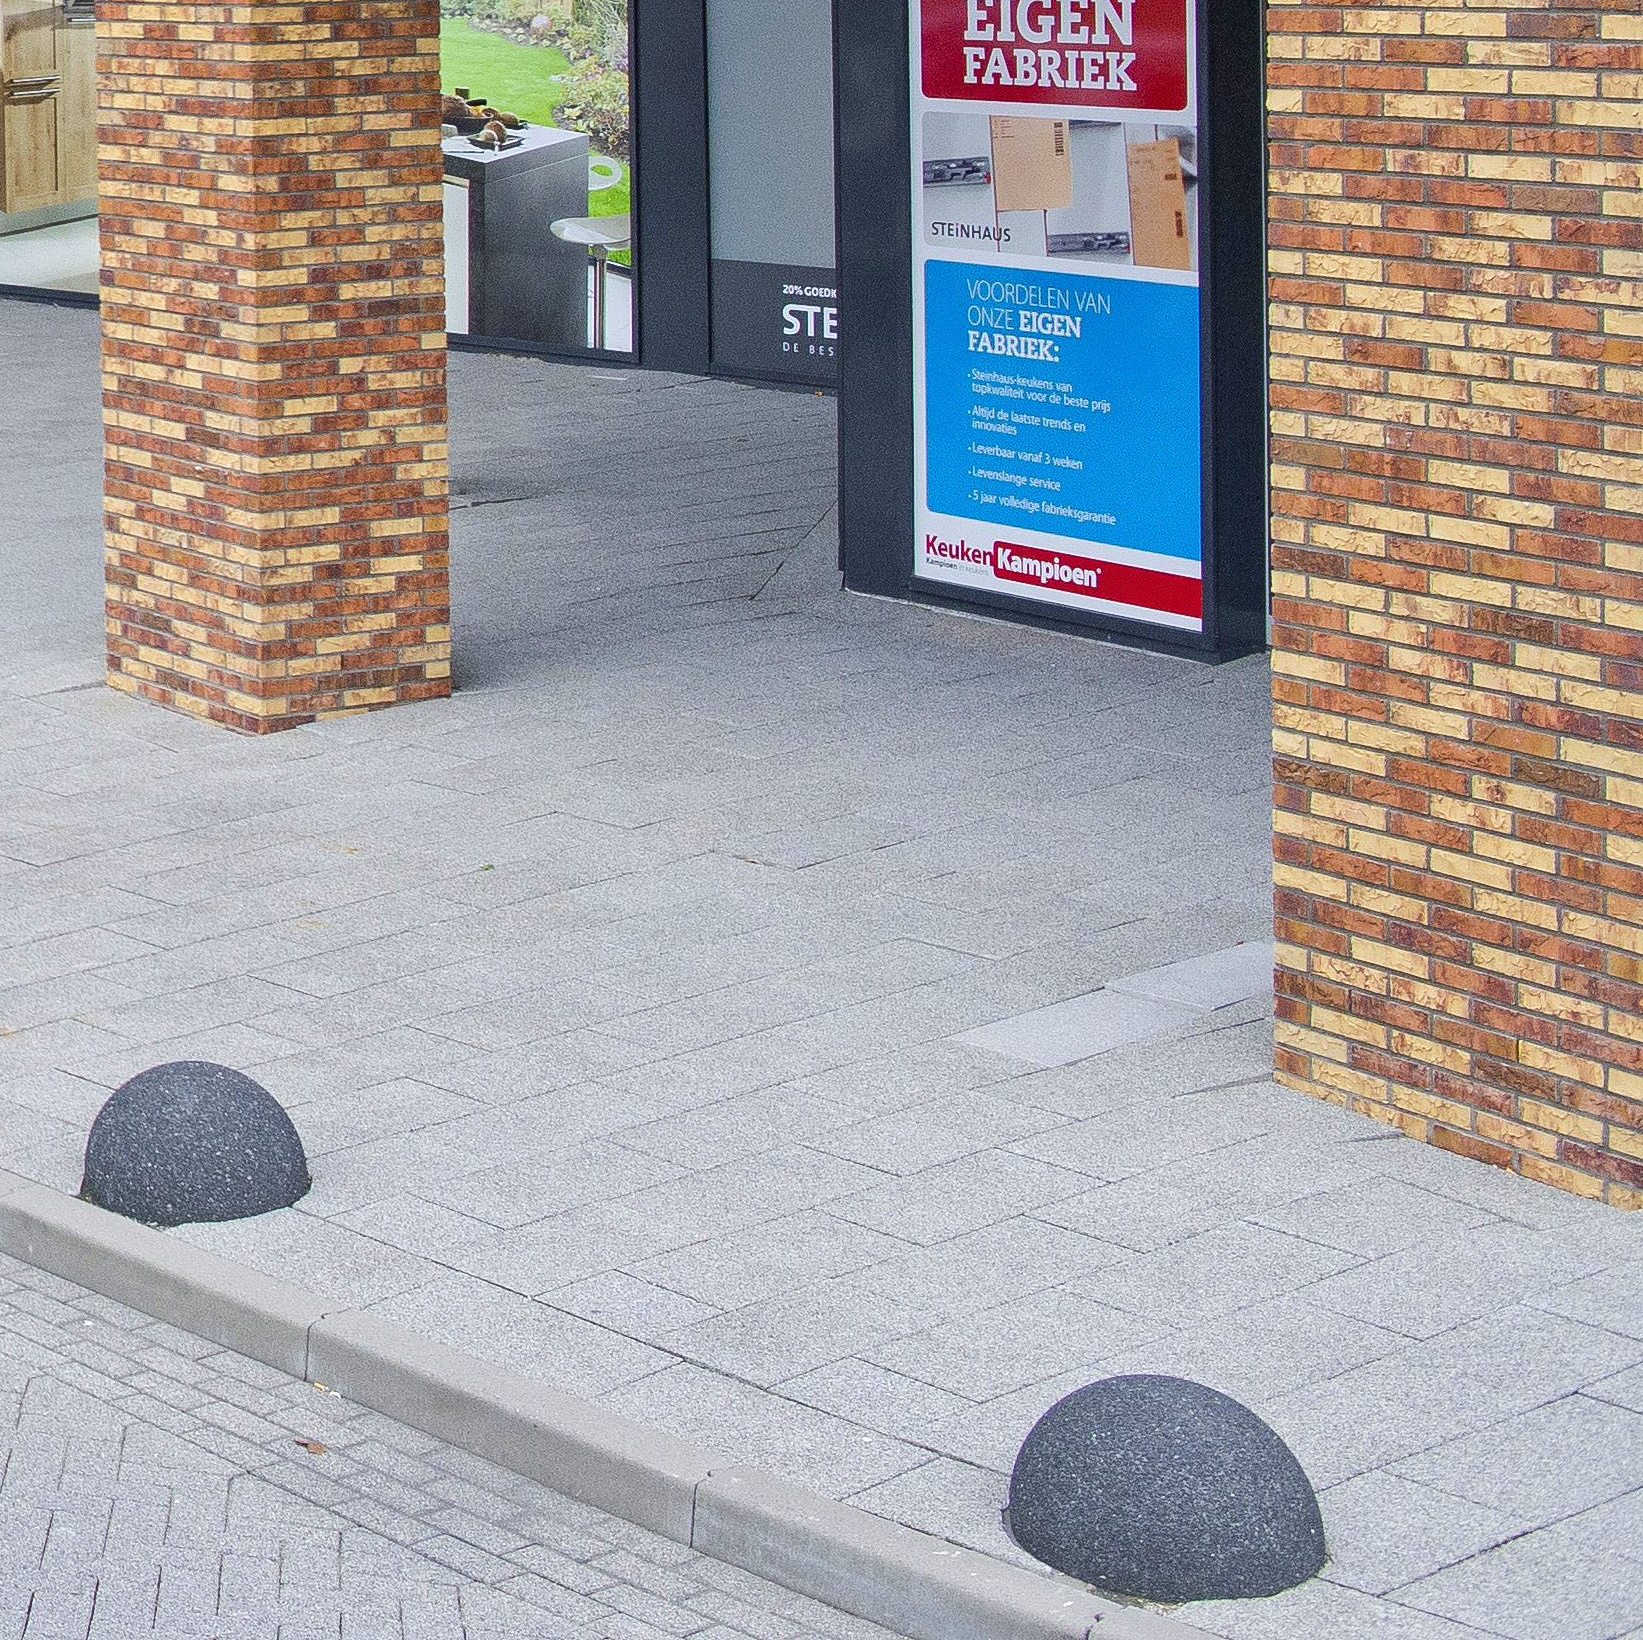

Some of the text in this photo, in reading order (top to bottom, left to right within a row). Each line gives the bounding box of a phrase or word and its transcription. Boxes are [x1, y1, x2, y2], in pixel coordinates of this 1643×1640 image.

[963, 47, 1138, 91] FABRIEK
[783, 284, 803, 295] 20%
[967, 279, 1111, 314] VOORDELEN VAN
[782, 303, 838, 339] STE
[967, 305, 1082, 338] ONZE EIGEN
[783, 341, 835, 356] DE BES
[967, 330, 1059, 363] FABRIEK:
[972, 368, 1072, 393] Steinhaus-keukens van
[972, 382, 1111, 413] topkwaliteit voor de beste prijs
[972, 405, 1086, 432] Altijd de laatste trends en
[972, 418, 1017, 435] innovaties
[972, 442, 1083, 470] Leverbaar vanaf 3 weken
[972, 466, 1061, 491] Levenslange service
[973, 489, 1116, 525] 5 jaar volledige fabrieksgarantie
[925, 534, 994, 566] Keuken
